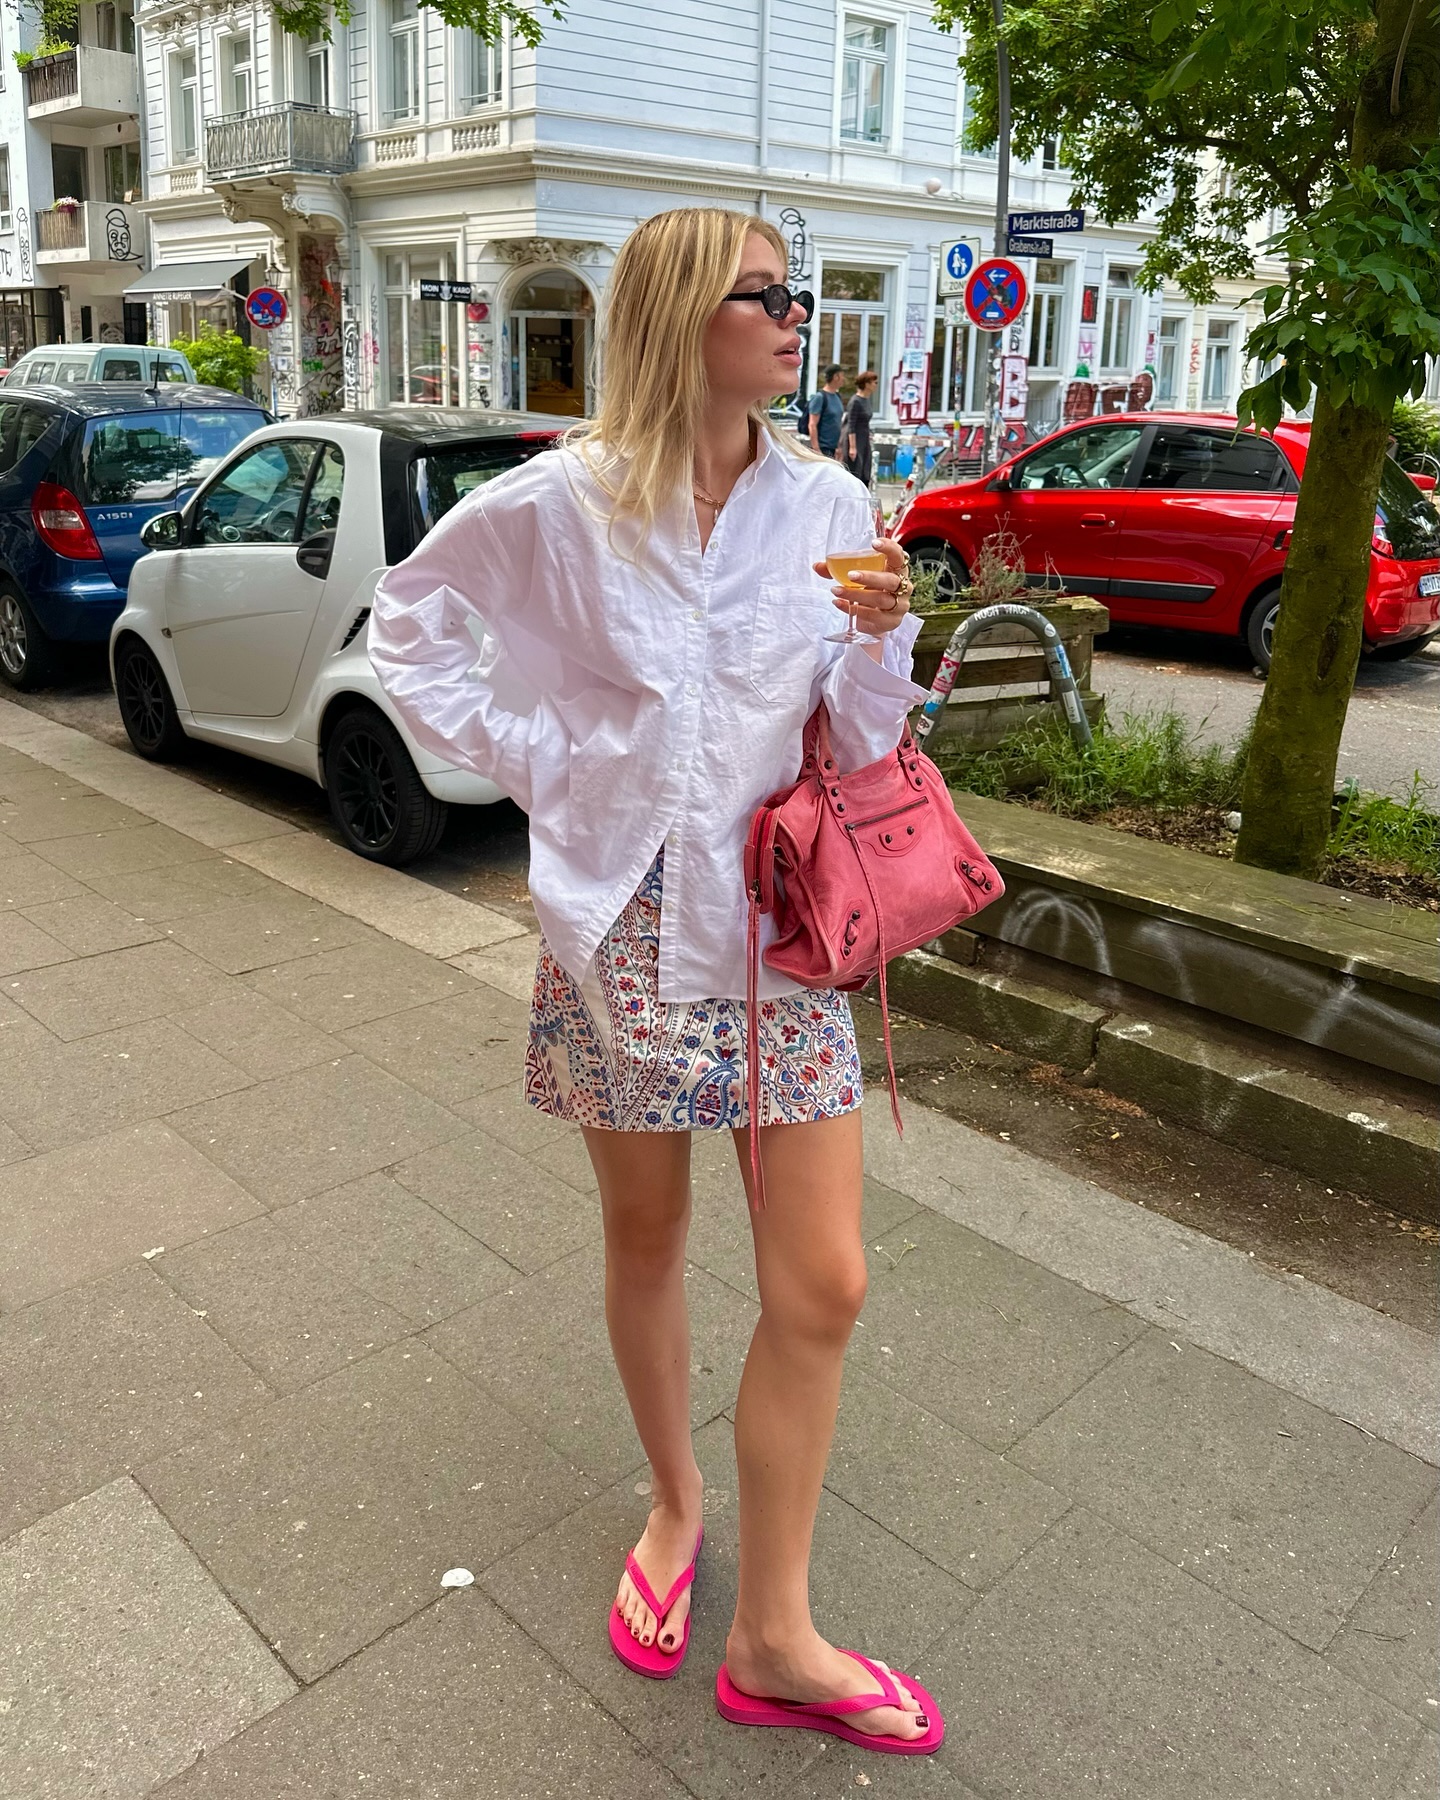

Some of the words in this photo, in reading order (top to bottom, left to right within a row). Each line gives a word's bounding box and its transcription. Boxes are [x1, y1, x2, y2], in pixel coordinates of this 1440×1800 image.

[1012, 214, 1079, 231] Marktstraße
[1009, 239, 1050, 254] Grabenstraße
[421, 284, 439, 292] MOIN
[948, 280, 967, 291] ZON
[973, 606, 999, 622] NOCH
